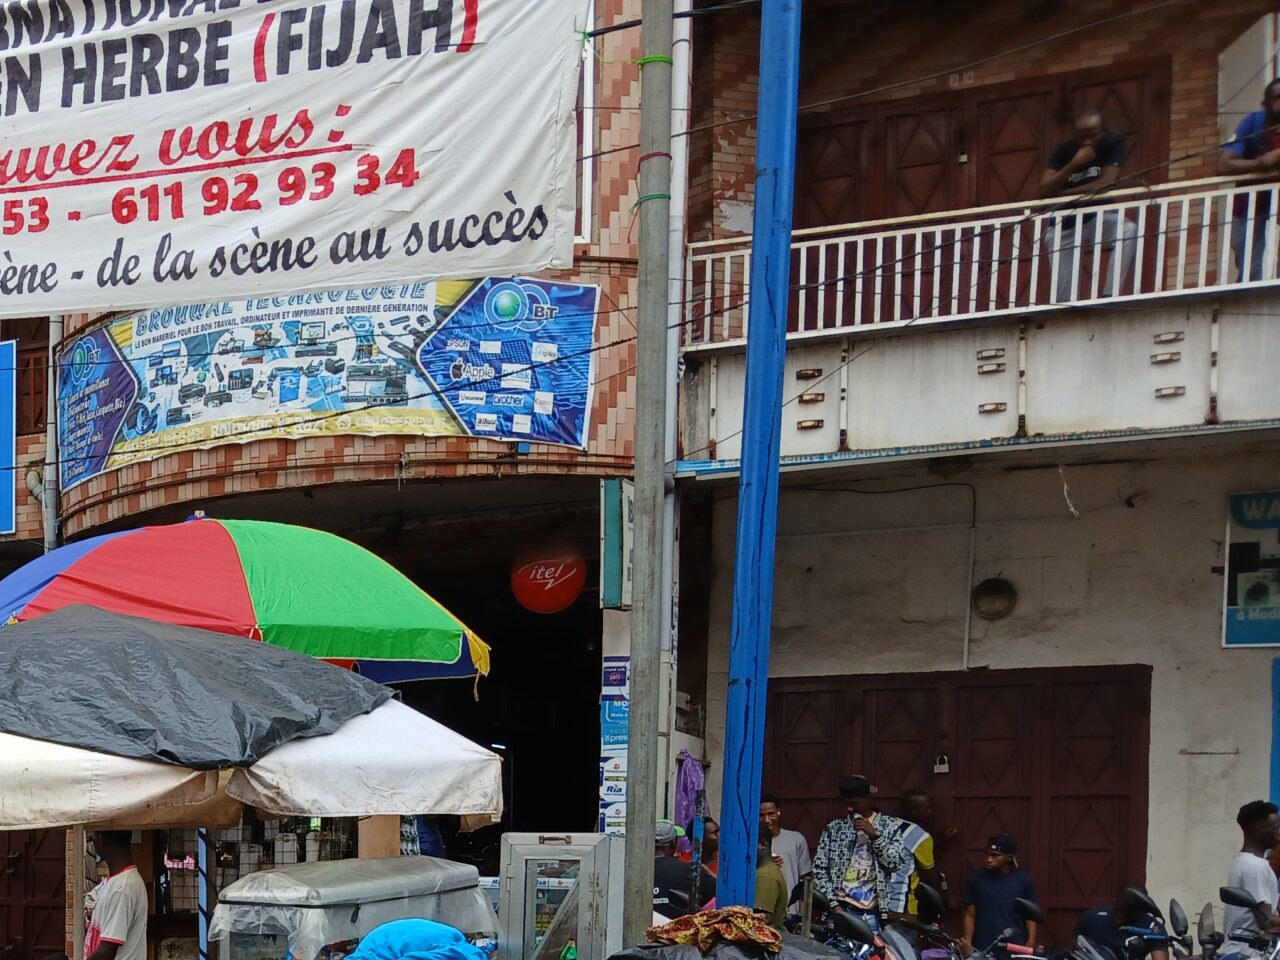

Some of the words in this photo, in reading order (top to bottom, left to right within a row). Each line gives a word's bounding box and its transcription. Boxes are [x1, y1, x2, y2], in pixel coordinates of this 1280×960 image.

[60, 20, 233, 108] HERBE
[253, 0, 479, 83] (FIJAH)
[2, 196, 50, 236] 53
[110, 180, 184, 225] 611
[201, 172, 261, 216] 92
[277, 166, 337, 207] 93
[352, 147, 420, 196] 34
[96, 236, 142, 289] de
[152, 232, 198, 283] la
[208, 227, 318, 278] scène
[329, 226, 393, 264] au
[403, 189, 550, 253] succès
[240, 311, 281, 325] ORDINATEUR
[282, 309, 290, 319] ET
[291, 307, 335, 318] IMPRIMANTE
[335, 306, 345, 315] DE
[532, 304, 559, 321] BT
[465, 363, 494, 382] Apple
[493, 393, 524, 406] brother
[606, 785, 623, 793] Ria
